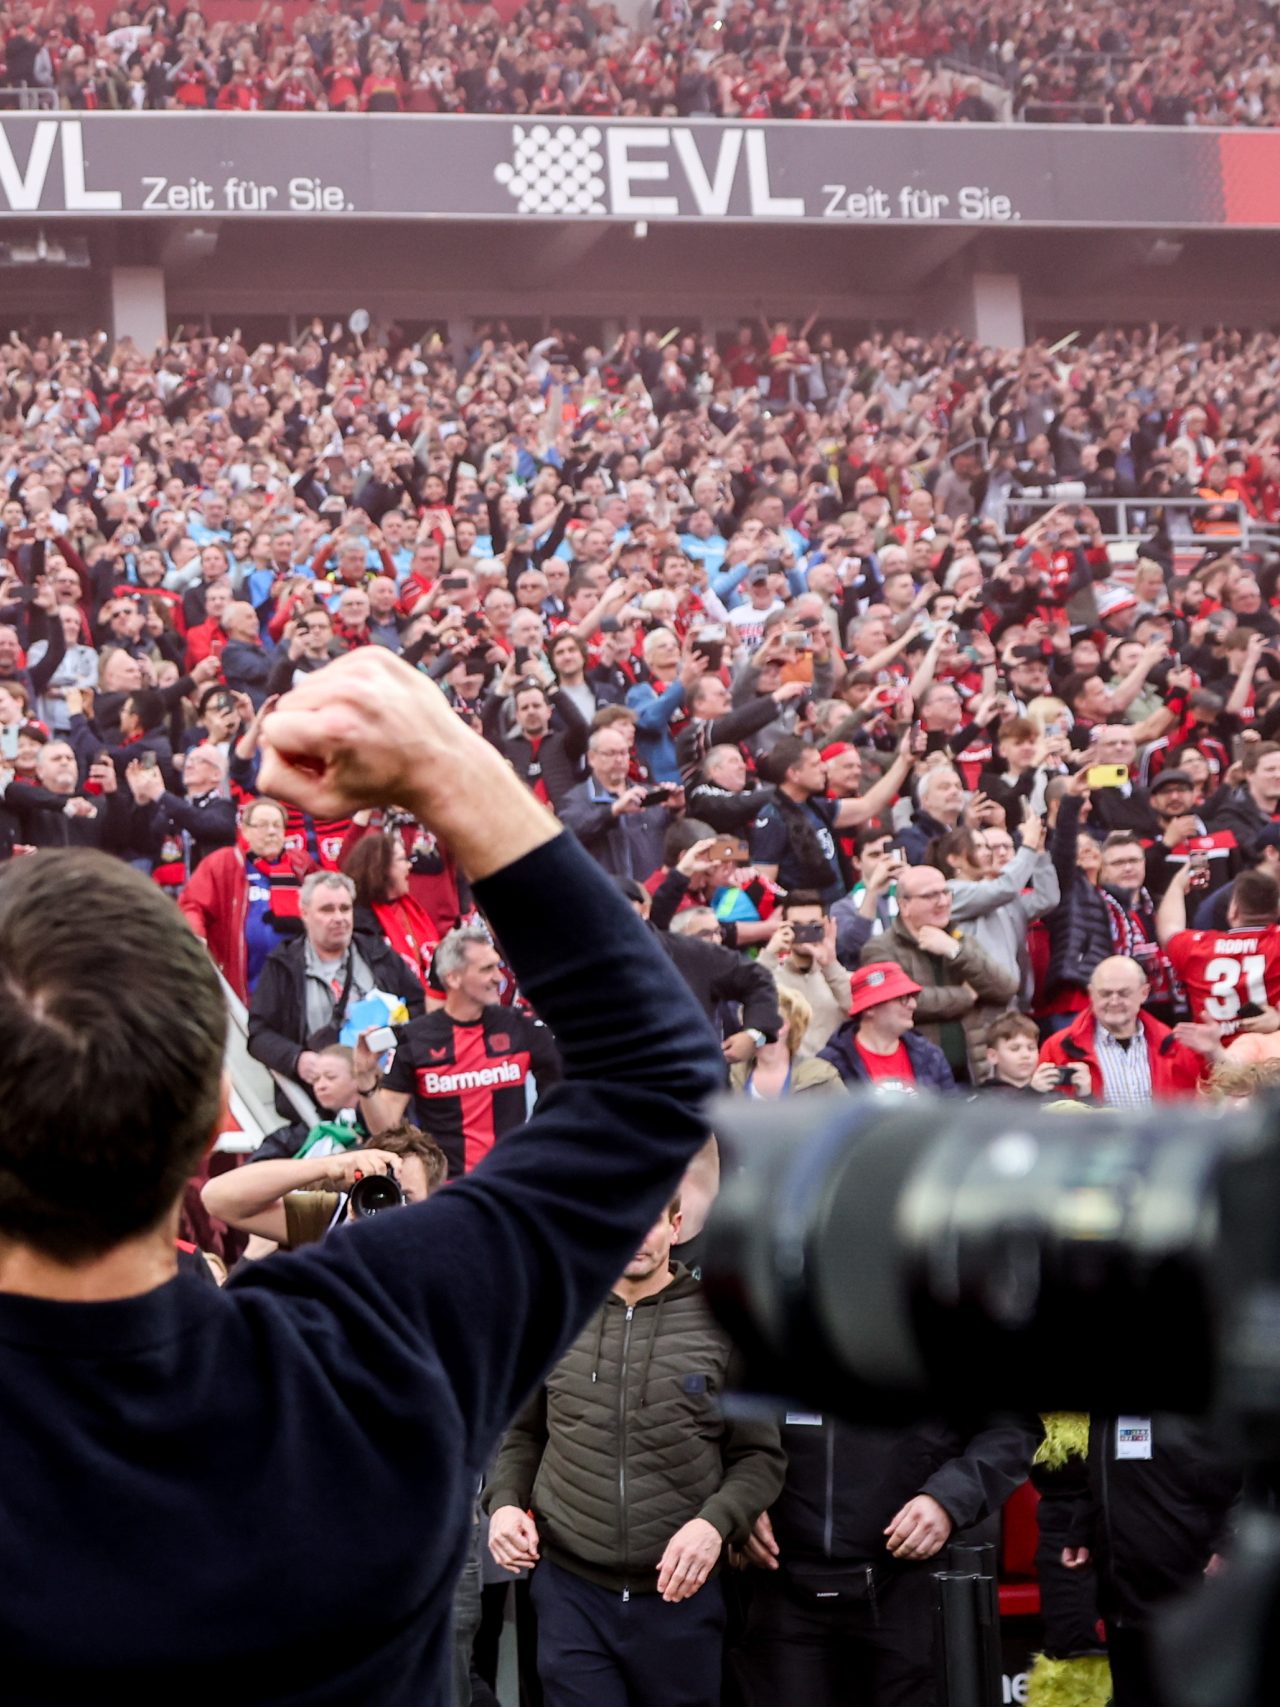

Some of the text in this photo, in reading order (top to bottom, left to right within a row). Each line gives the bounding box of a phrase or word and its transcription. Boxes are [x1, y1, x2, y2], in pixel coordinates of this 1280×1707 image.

[606, 126, 806, 216] EVL
[141, 176, 356, 211] Zeit für Sie.
[821, 184, 1021, 221] Zeit für Sie.
[1204, 954, 1267, 1021] 31
[424, 1060, 520, 1093] Barmenia
